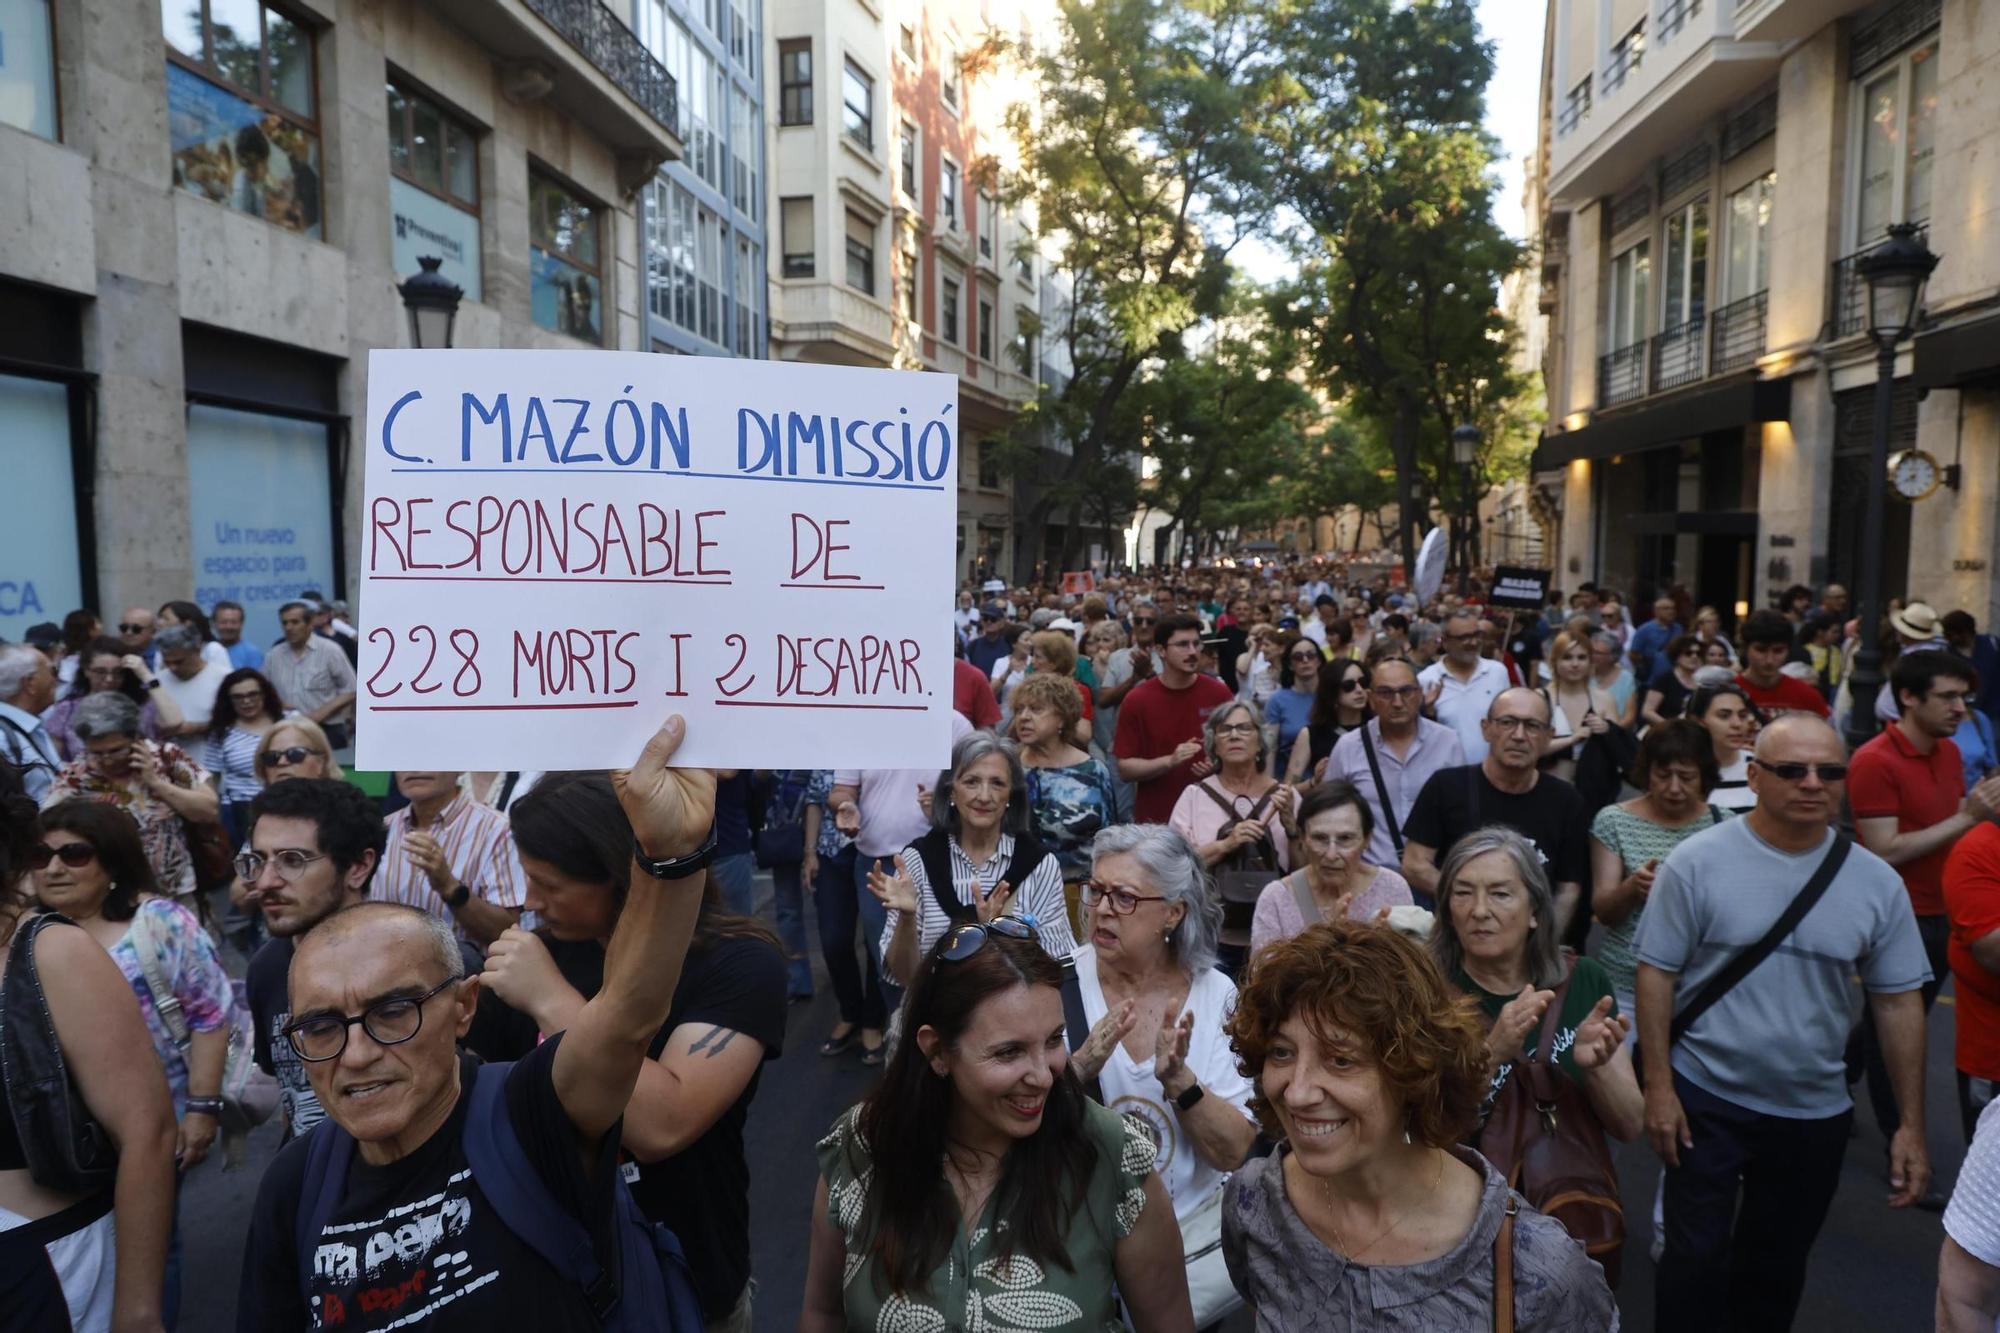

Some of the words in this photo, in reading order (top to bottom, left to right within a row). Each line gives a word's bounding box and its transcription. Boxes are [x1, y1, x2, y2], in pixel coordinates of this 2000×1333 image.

[382, 390, 433, 464] C.
[462, 385, 690, 470] MAZÓN
[203, 556, 269, 579] espacio
[272, 555, 306, 577] para
[215, 521, 241, 544] Un
[244, 528, 296, 545] nuevo
[371, 496, 731, 577] RESPONSABLE
[791, 513, 861, 581] DE
[367, 625, 482, 697] 228
[513, 629, 640, 698] MORTS
[666, 633, 692, 697] I
[716, 634, 755, 697] 2
[777, 634, 933, 697] DESAPAR.
